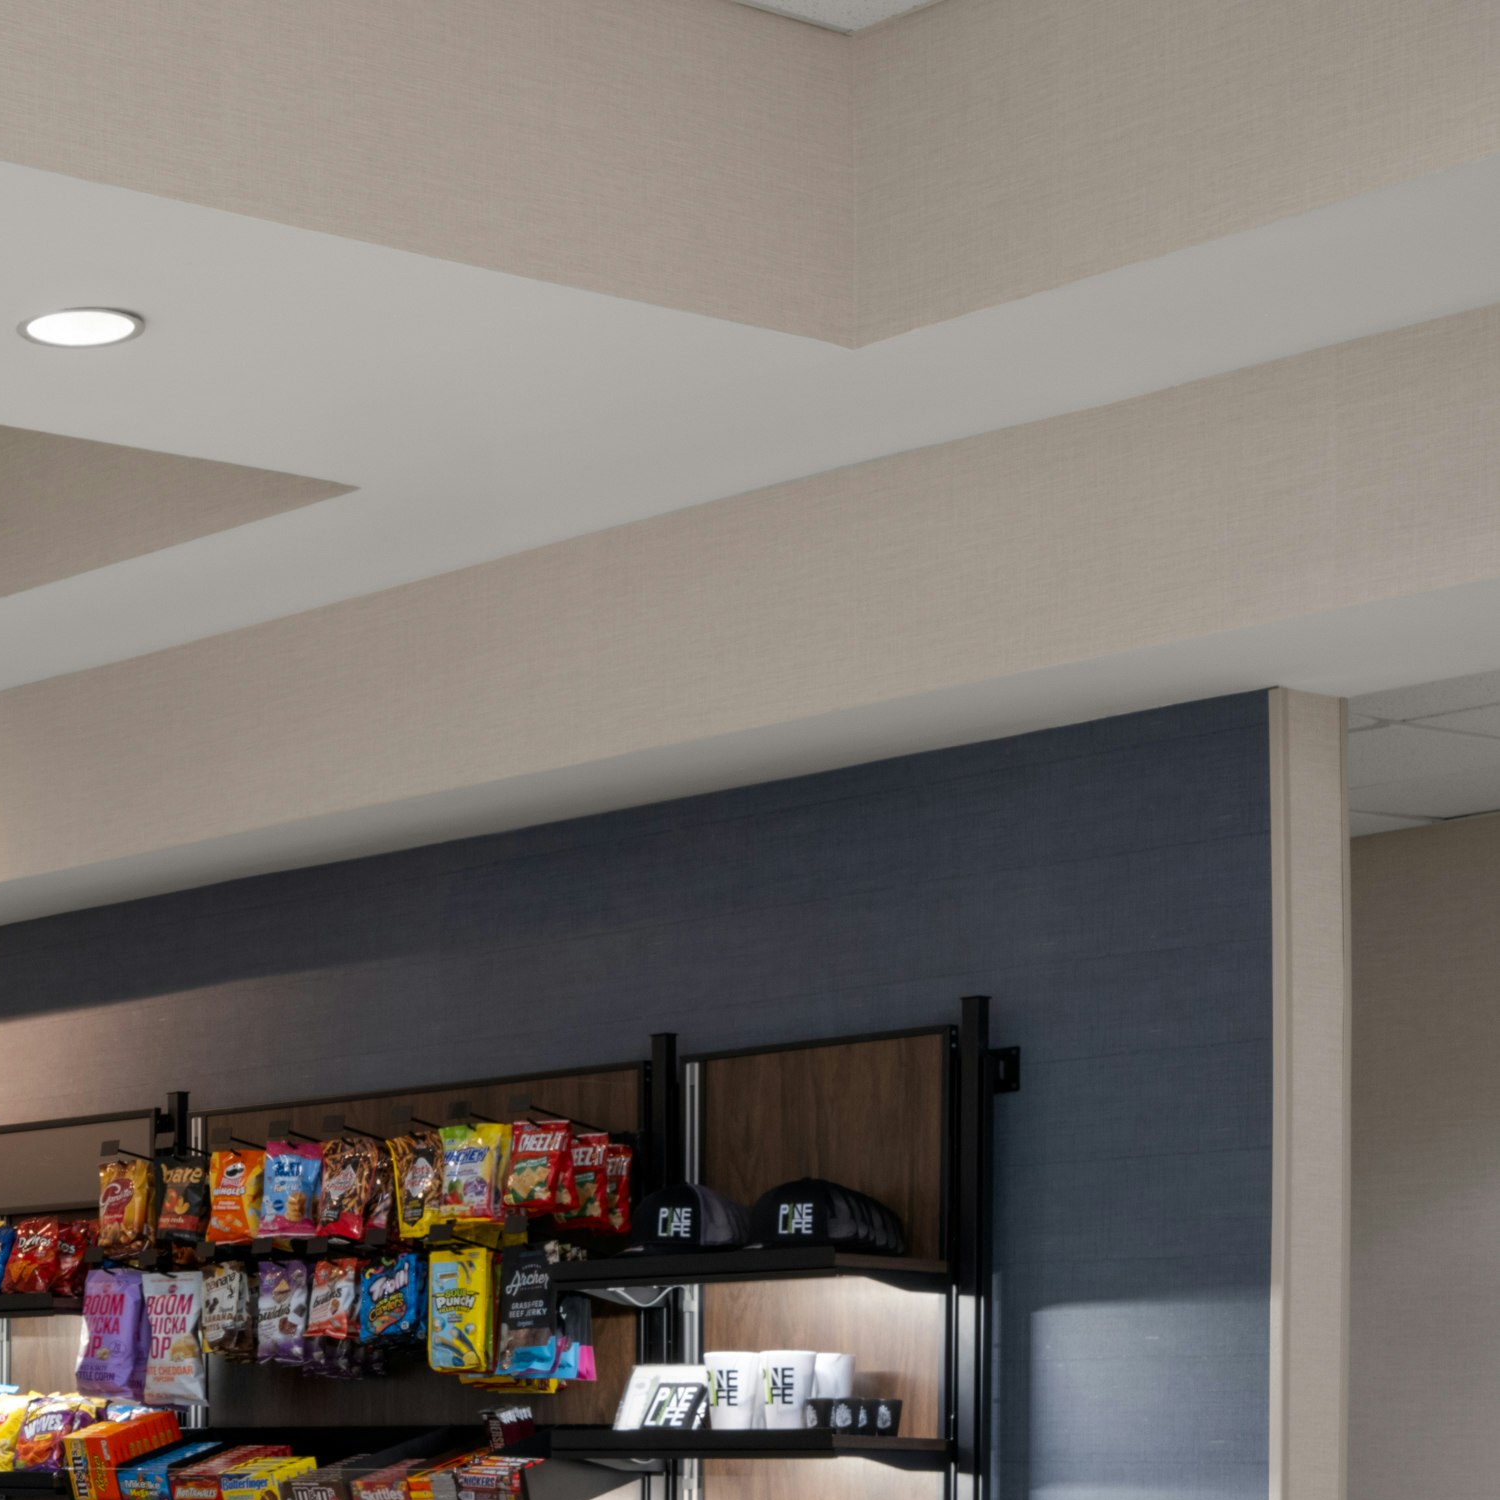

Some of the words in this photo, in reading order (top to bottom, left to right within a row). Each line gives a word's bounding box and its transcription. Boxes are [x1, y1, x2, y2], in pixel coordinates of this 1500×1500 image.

[571, 1145, 606, 1167] EEZ-IT
[160, 1162, 203, 1184] bare
[505, 1269, 550, 1297] Archer
[146, 1293, 194, 1316] BOOM
[435, 1295, 476, 1309] PUNCH
[525, 1307, 548, 1317] JERKY
[150, 1316, 187, 1335] HICKA
[151, 1336, 172, 1360] OP
[221, 1477, 268, 1491] Butterfinger
